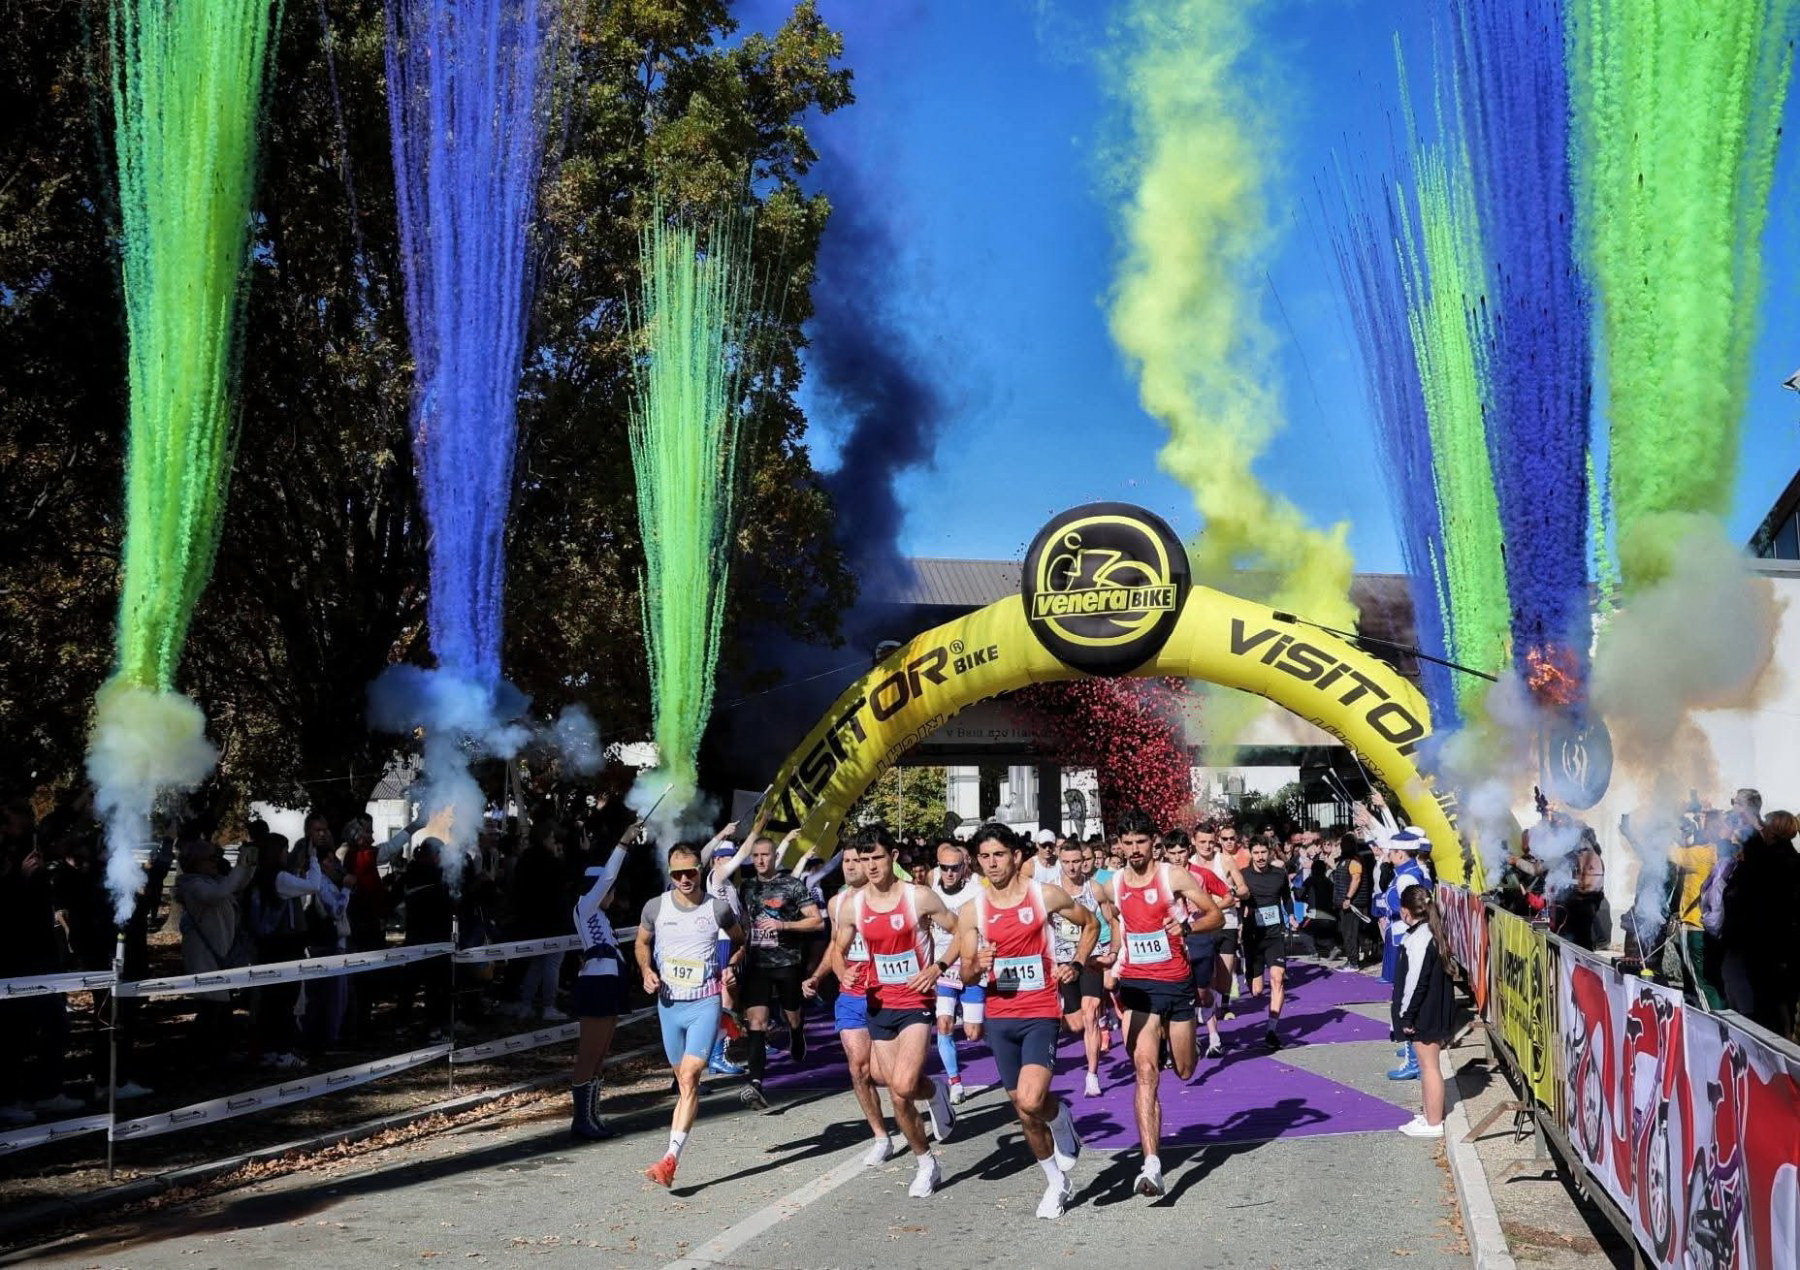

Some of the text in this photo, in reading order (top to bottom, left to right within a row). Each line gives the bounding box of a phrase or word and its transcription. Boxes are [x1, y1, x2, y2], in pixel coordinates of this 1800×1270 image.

[1037, 588, 1172, 616] venera BIKE
[953, 645, 999, 675] BIKE
[1231, 618, 1424, 757] VISITO
[1133, 940, 1162, 954] 1118
[673, 965, 694, 980] 197
[882, 959, 909, 975] 1117
[1003, 965, 1036, 980] 1115
